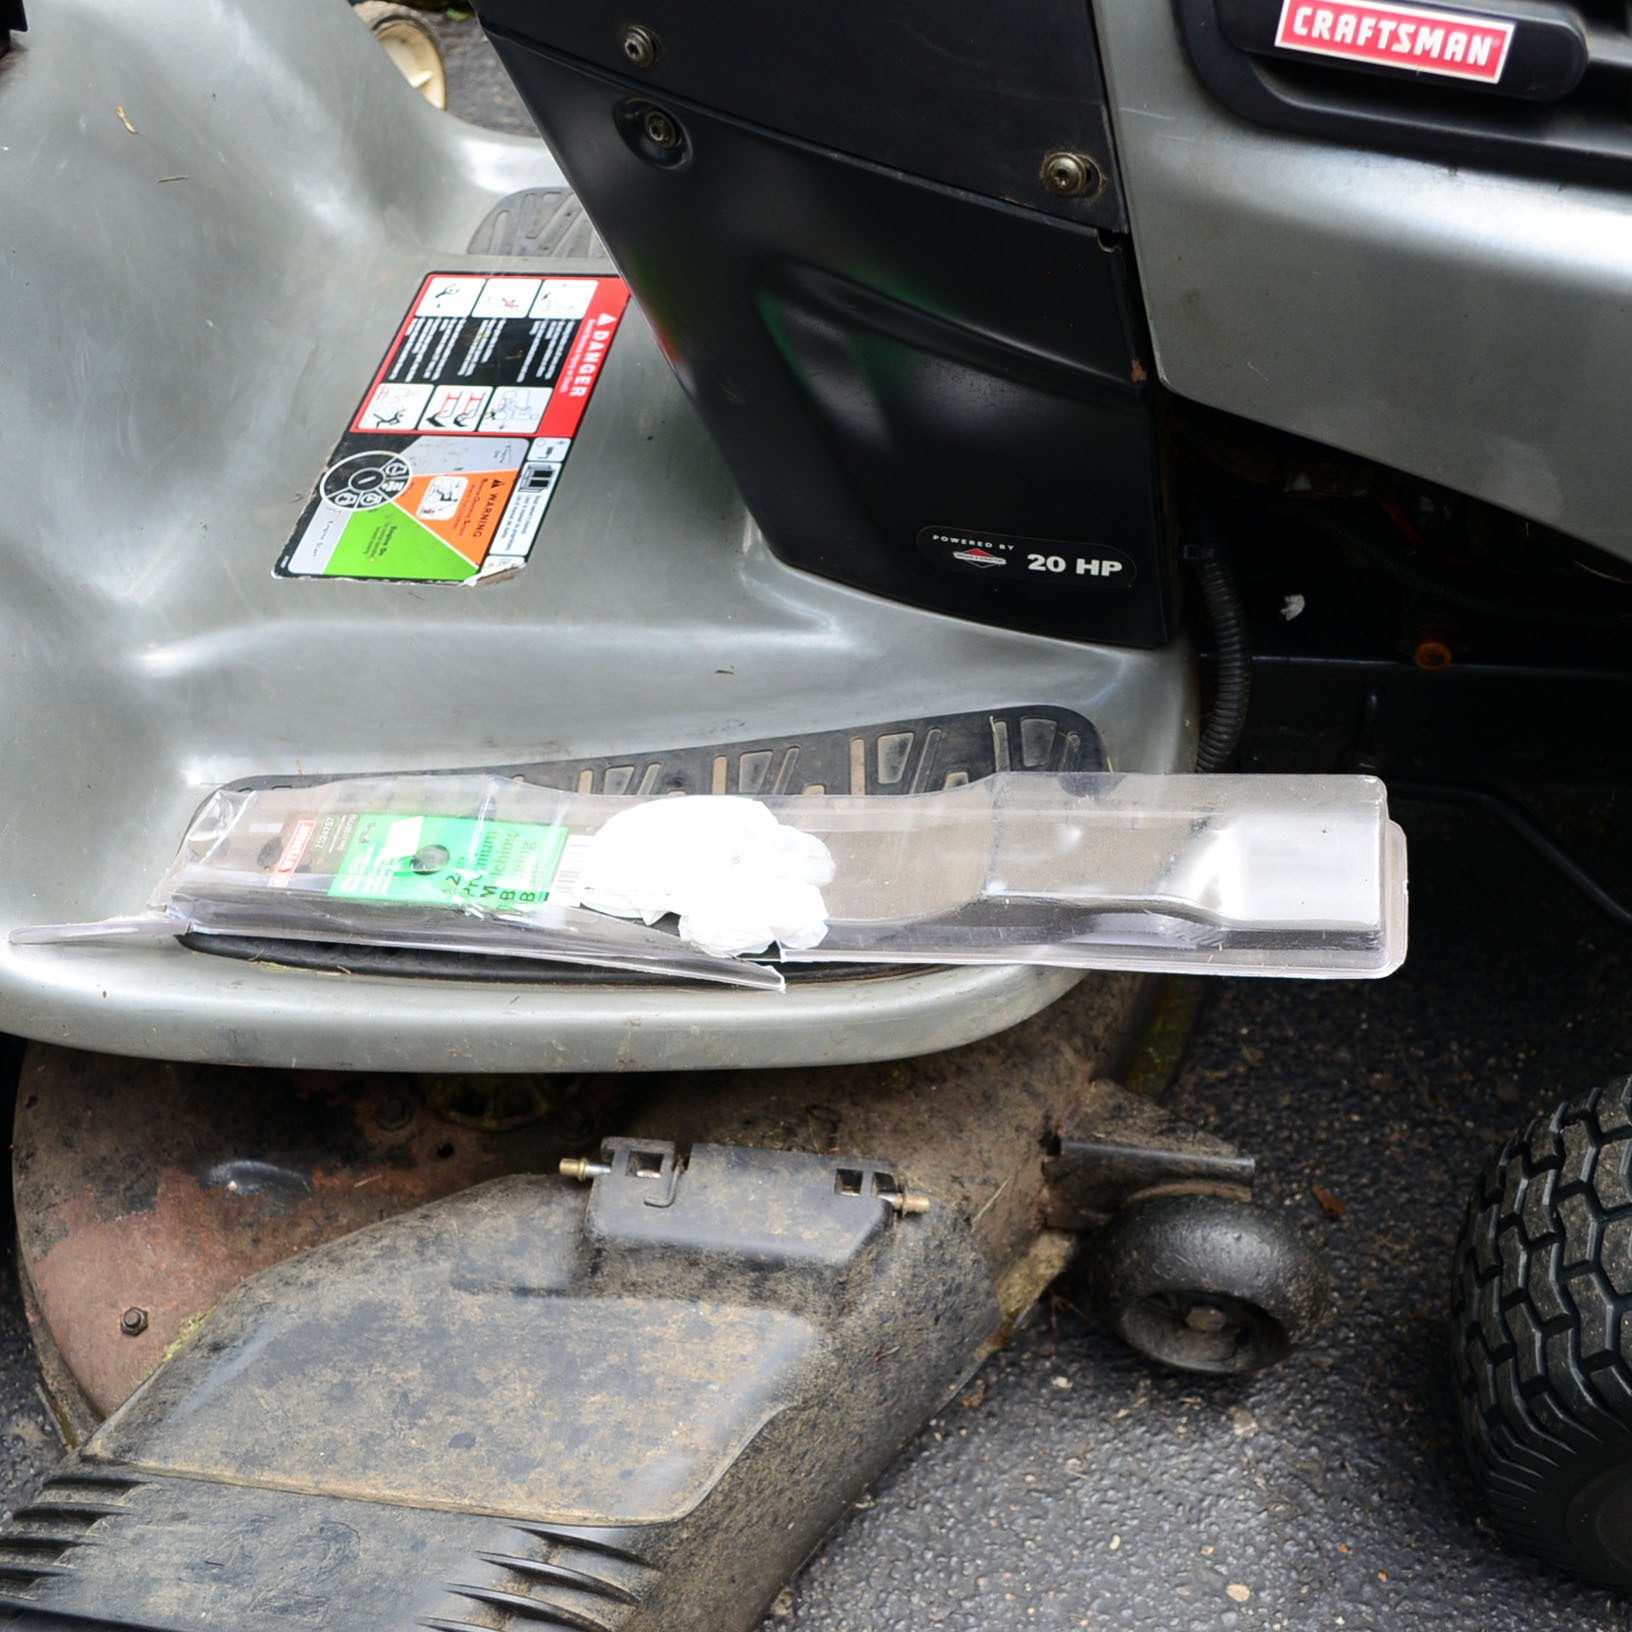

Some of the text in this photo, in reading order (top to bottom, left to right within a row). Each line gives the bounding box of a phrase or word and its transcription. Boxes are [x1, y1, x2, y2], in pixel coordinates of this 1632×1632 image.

[1293, 6, 1493, 66] CRAFTSMAN
[569, 330, 610, 397] DANGER
[473, 493, 497, 537] WARNING
[932, 534, 1015, 551] POWERED BY
[1027, 553, 1067, 573] 20
[1076, 558, 1123, 577] HP
